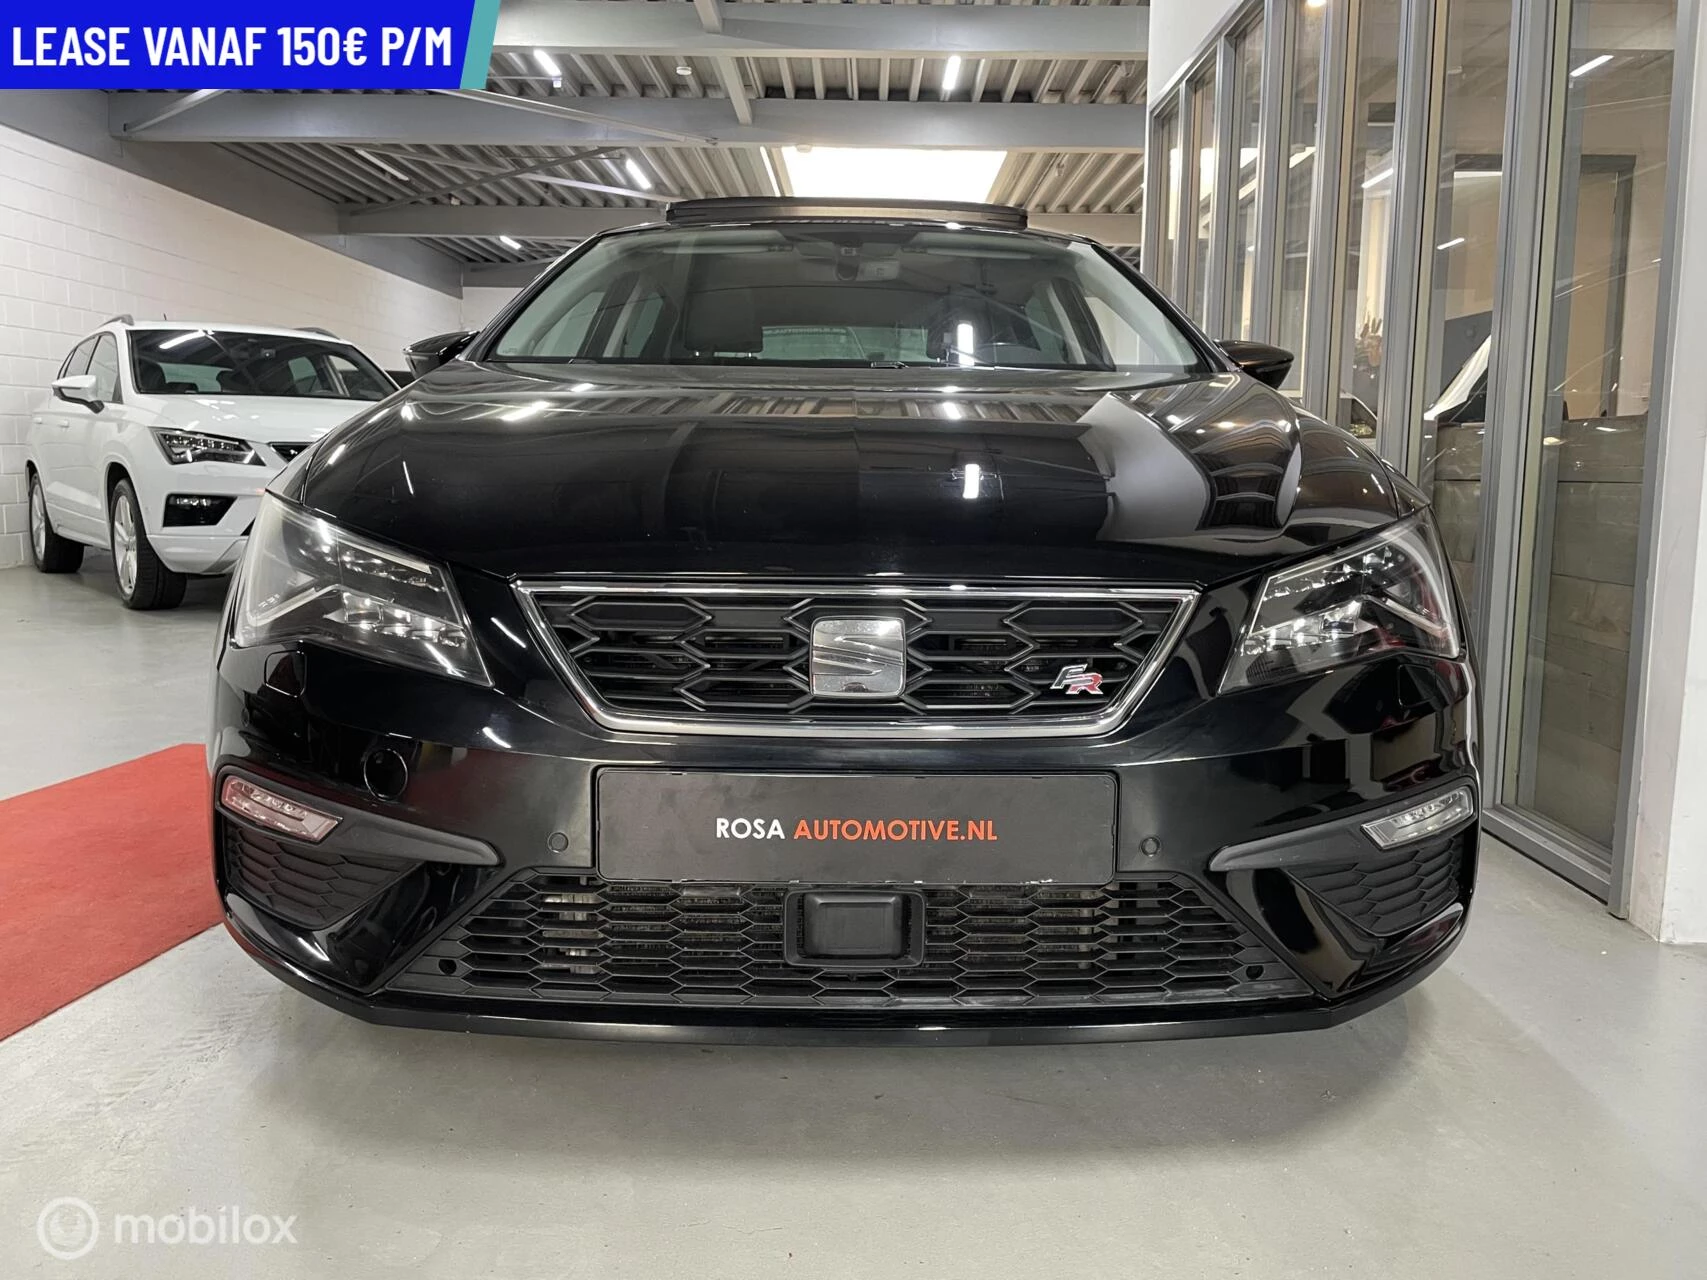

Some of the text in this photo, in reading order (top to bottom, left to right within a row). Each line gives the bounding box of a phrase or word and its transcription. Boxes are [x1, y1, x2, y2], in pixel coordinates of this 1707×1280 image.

[1050, 664, 1104, 694] FR
[716, 817, 998, 841] ROSA AUTOMOTIVE.NL
